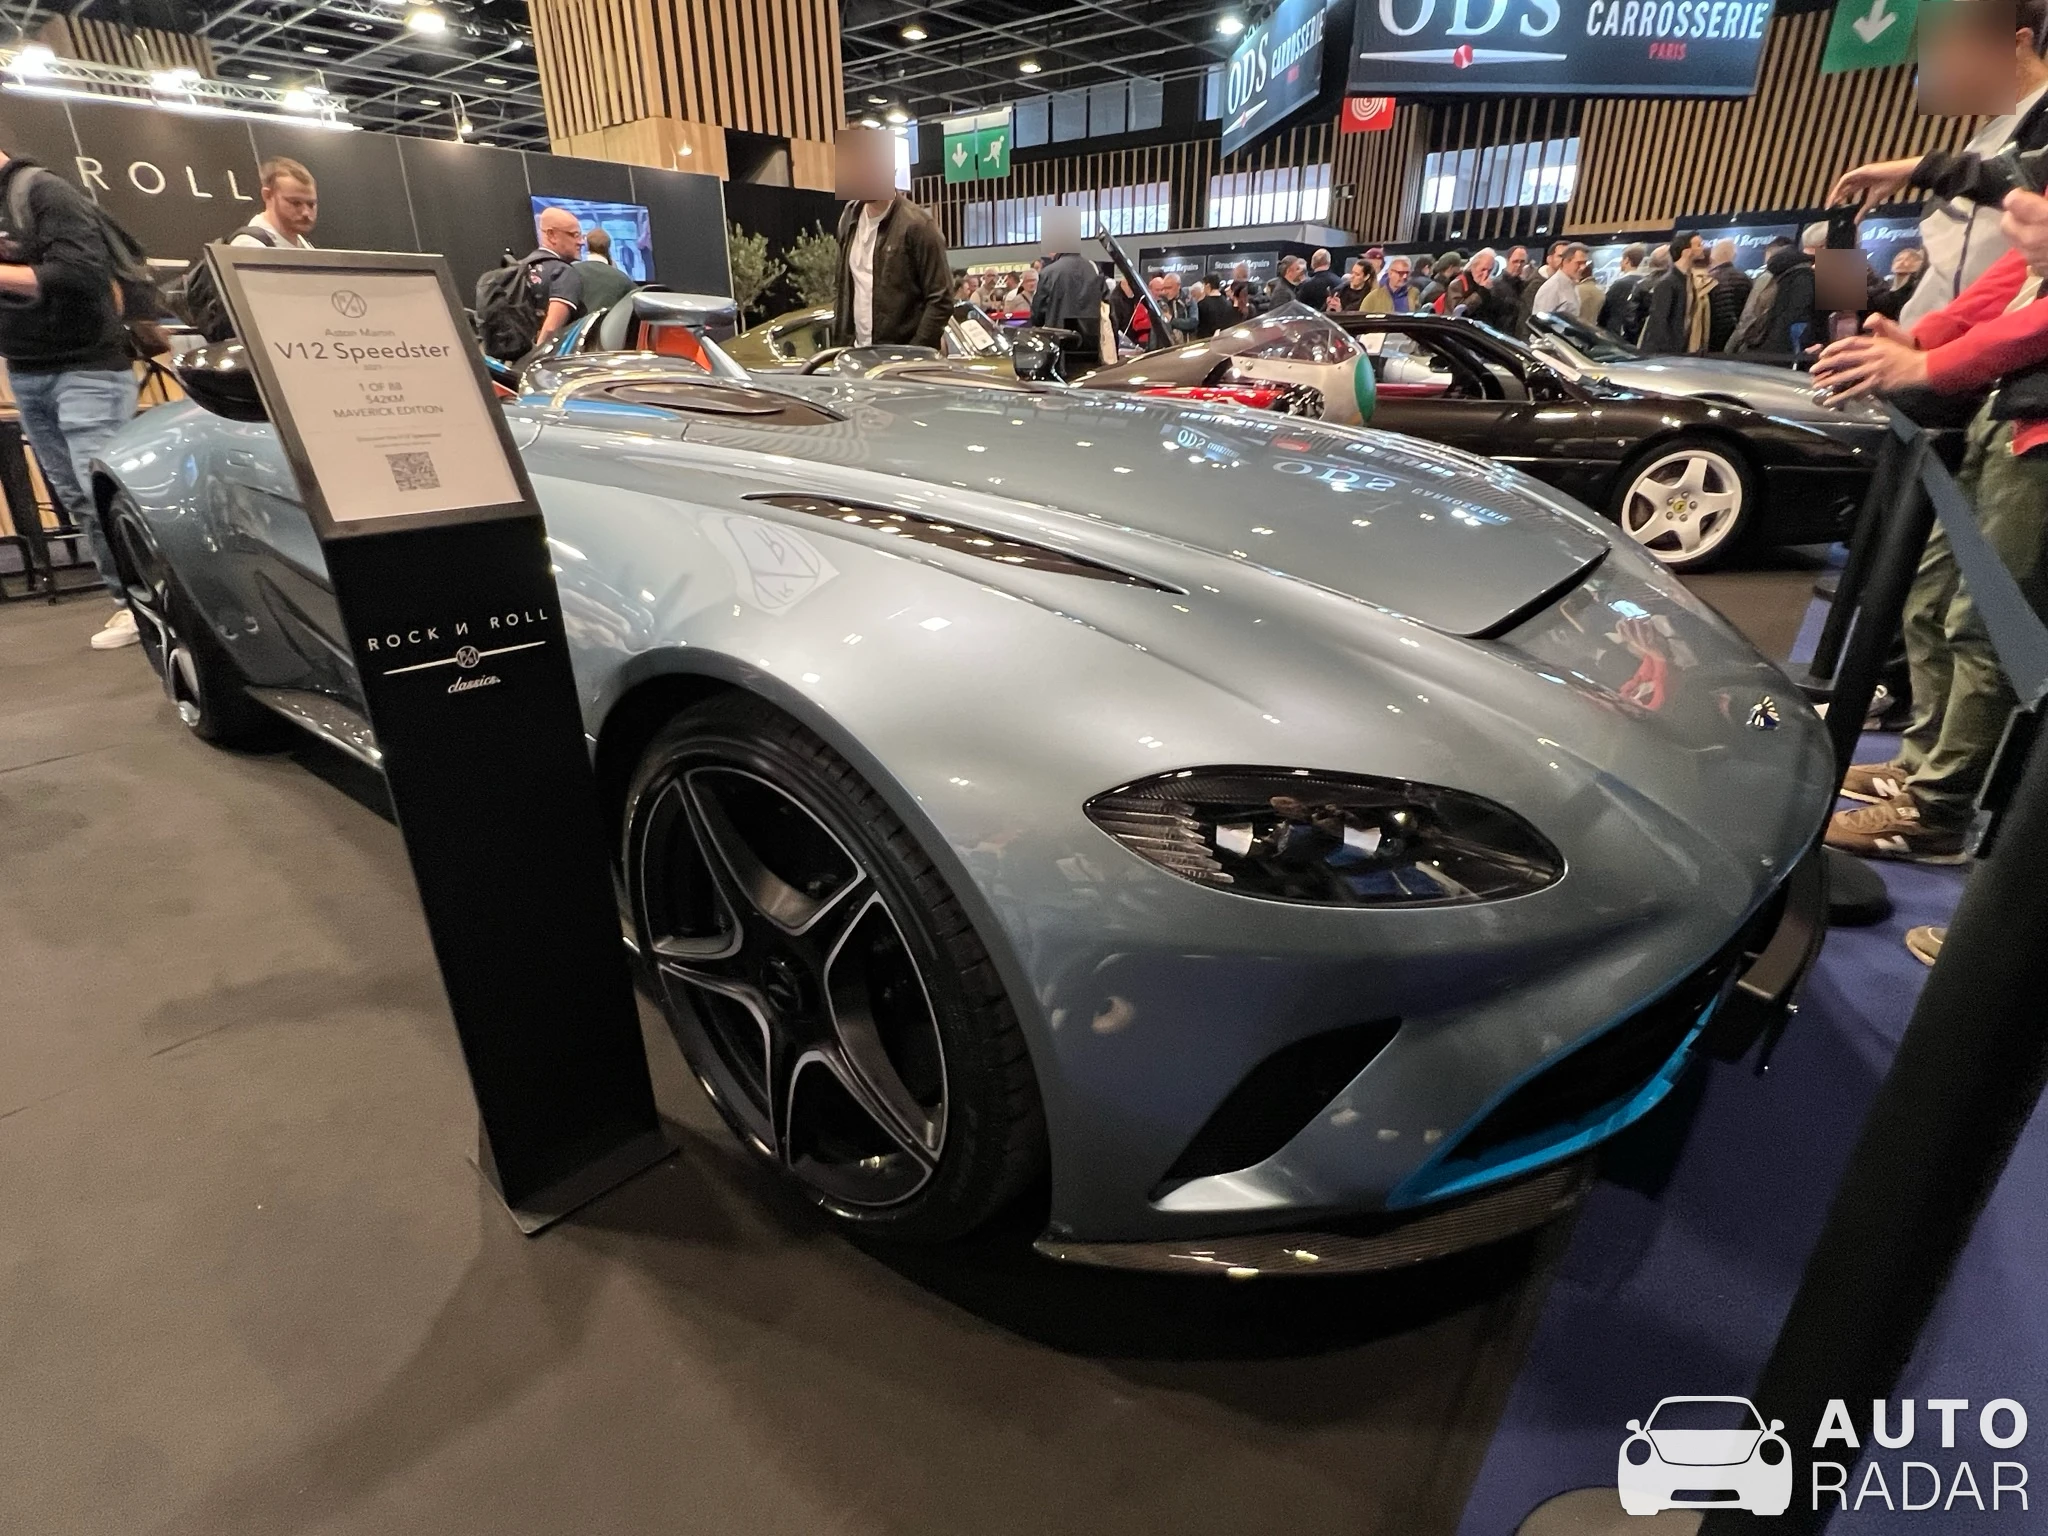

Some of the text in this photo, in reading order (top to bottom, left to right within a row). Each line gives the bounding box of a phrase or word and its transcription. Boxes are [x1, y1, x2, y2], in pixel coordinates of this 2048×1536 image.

[1585, 0, 1769, 39] CARROSSERIE
[1648, 42, 1688, 60] PARIS
[1228, 32, 1269, 115] ODS
[75, 156, 254, 201] ROLL
[274, 340, 450, 364] V12 Speedster
[358, 382, 365, 392] 1
[368, 382, 384, 392] OF
[333, 405, 444, 418] MAVERICK EDITION
[367, 627, 439, 651] ROCK
[490, 608, 548, 629] ROLL
